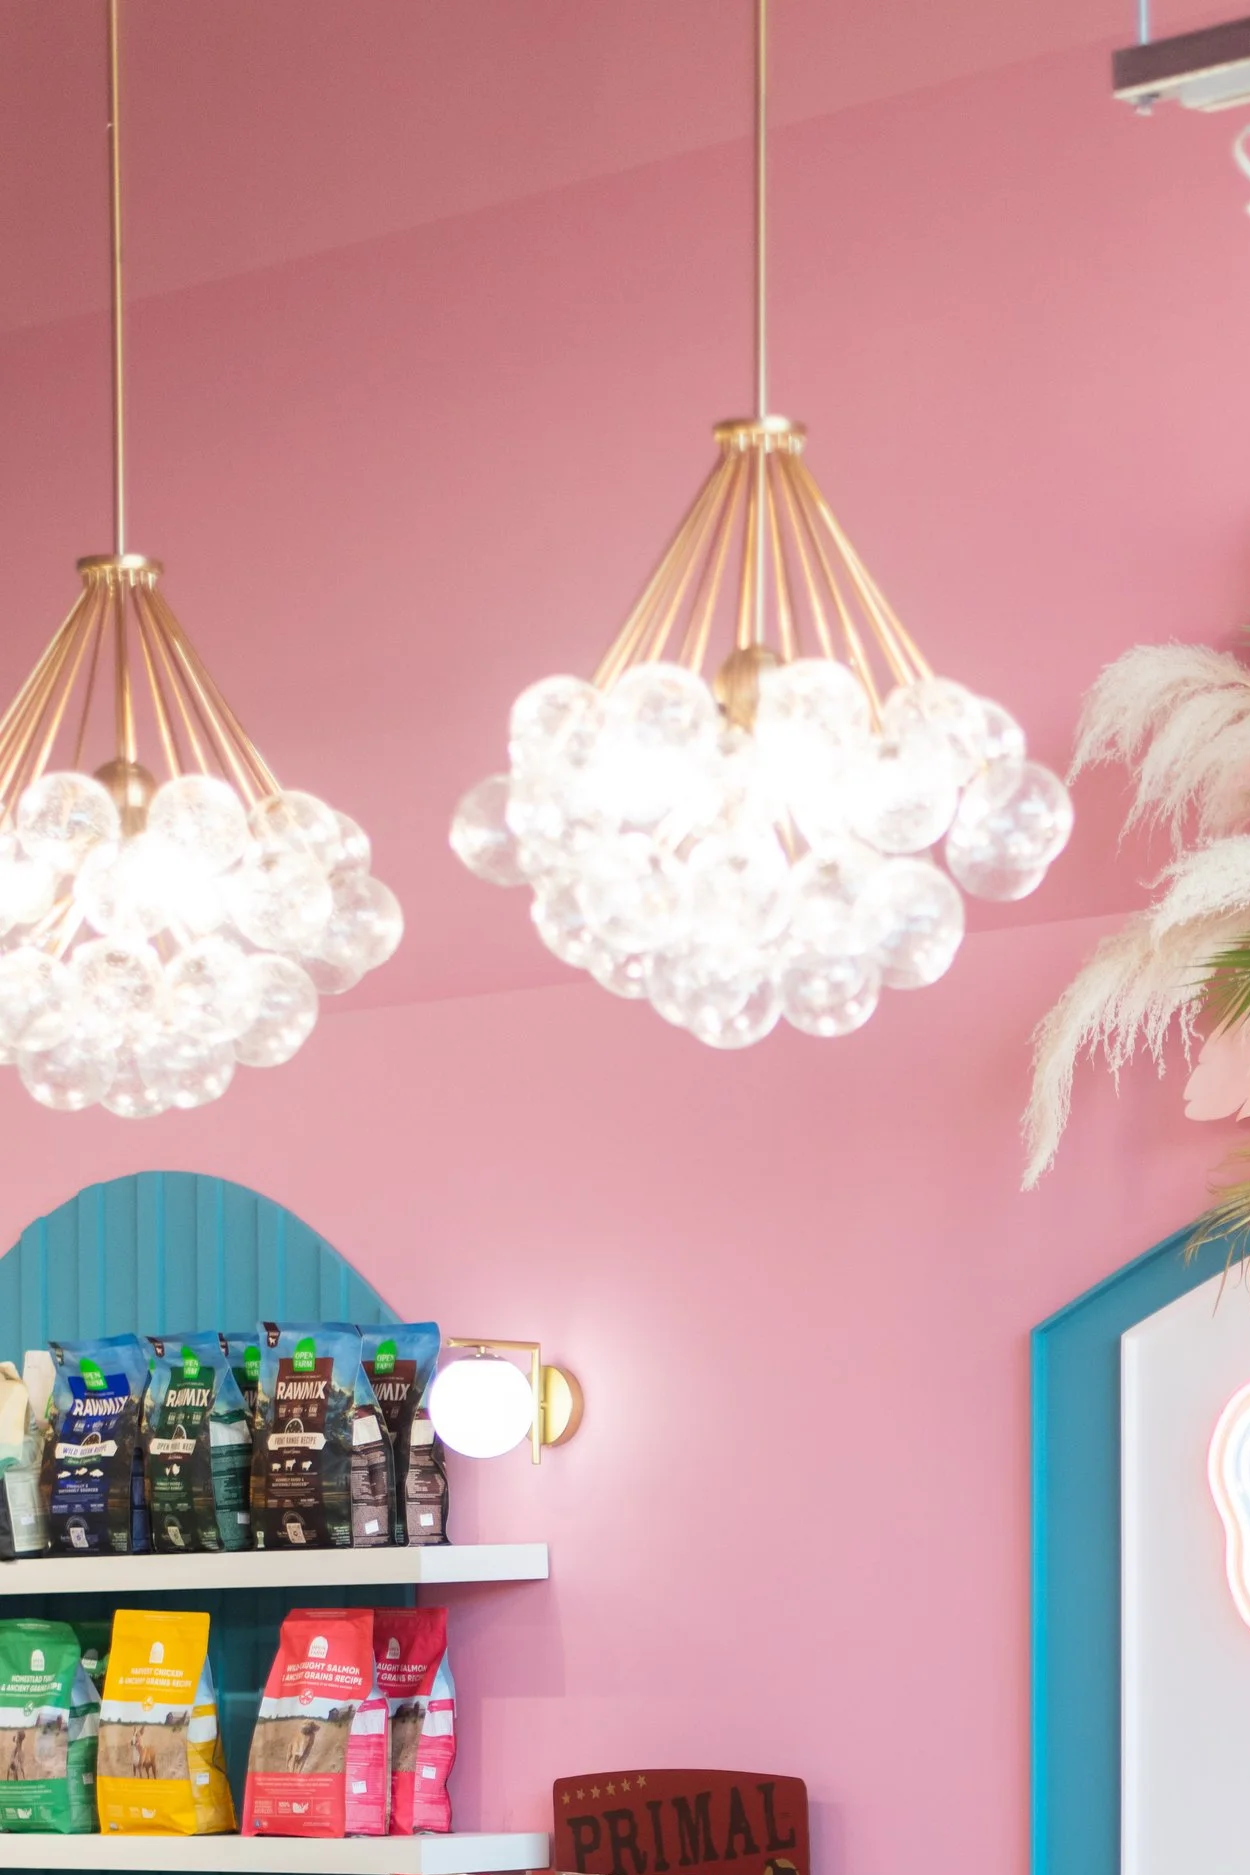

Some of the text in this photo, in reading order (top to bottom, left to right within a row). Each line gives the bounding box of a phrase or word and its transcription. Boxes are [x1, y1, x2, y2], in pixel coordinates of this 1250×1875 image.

[294, 1352, 313, 1360] OPEN
[294, 1360, 313, 1369] FARM
[165, 1388, 210, 1407] RAWMIX
[277, 1381, 327, 1400] RAWMIX
[72, 1396, 128, 1416] RAWMIX
[326, 1663, 360, 1675] SALMON
[304, 1671, 333, 1682] GRAINS
[335, 1674, 363, 1686] RECIPE
